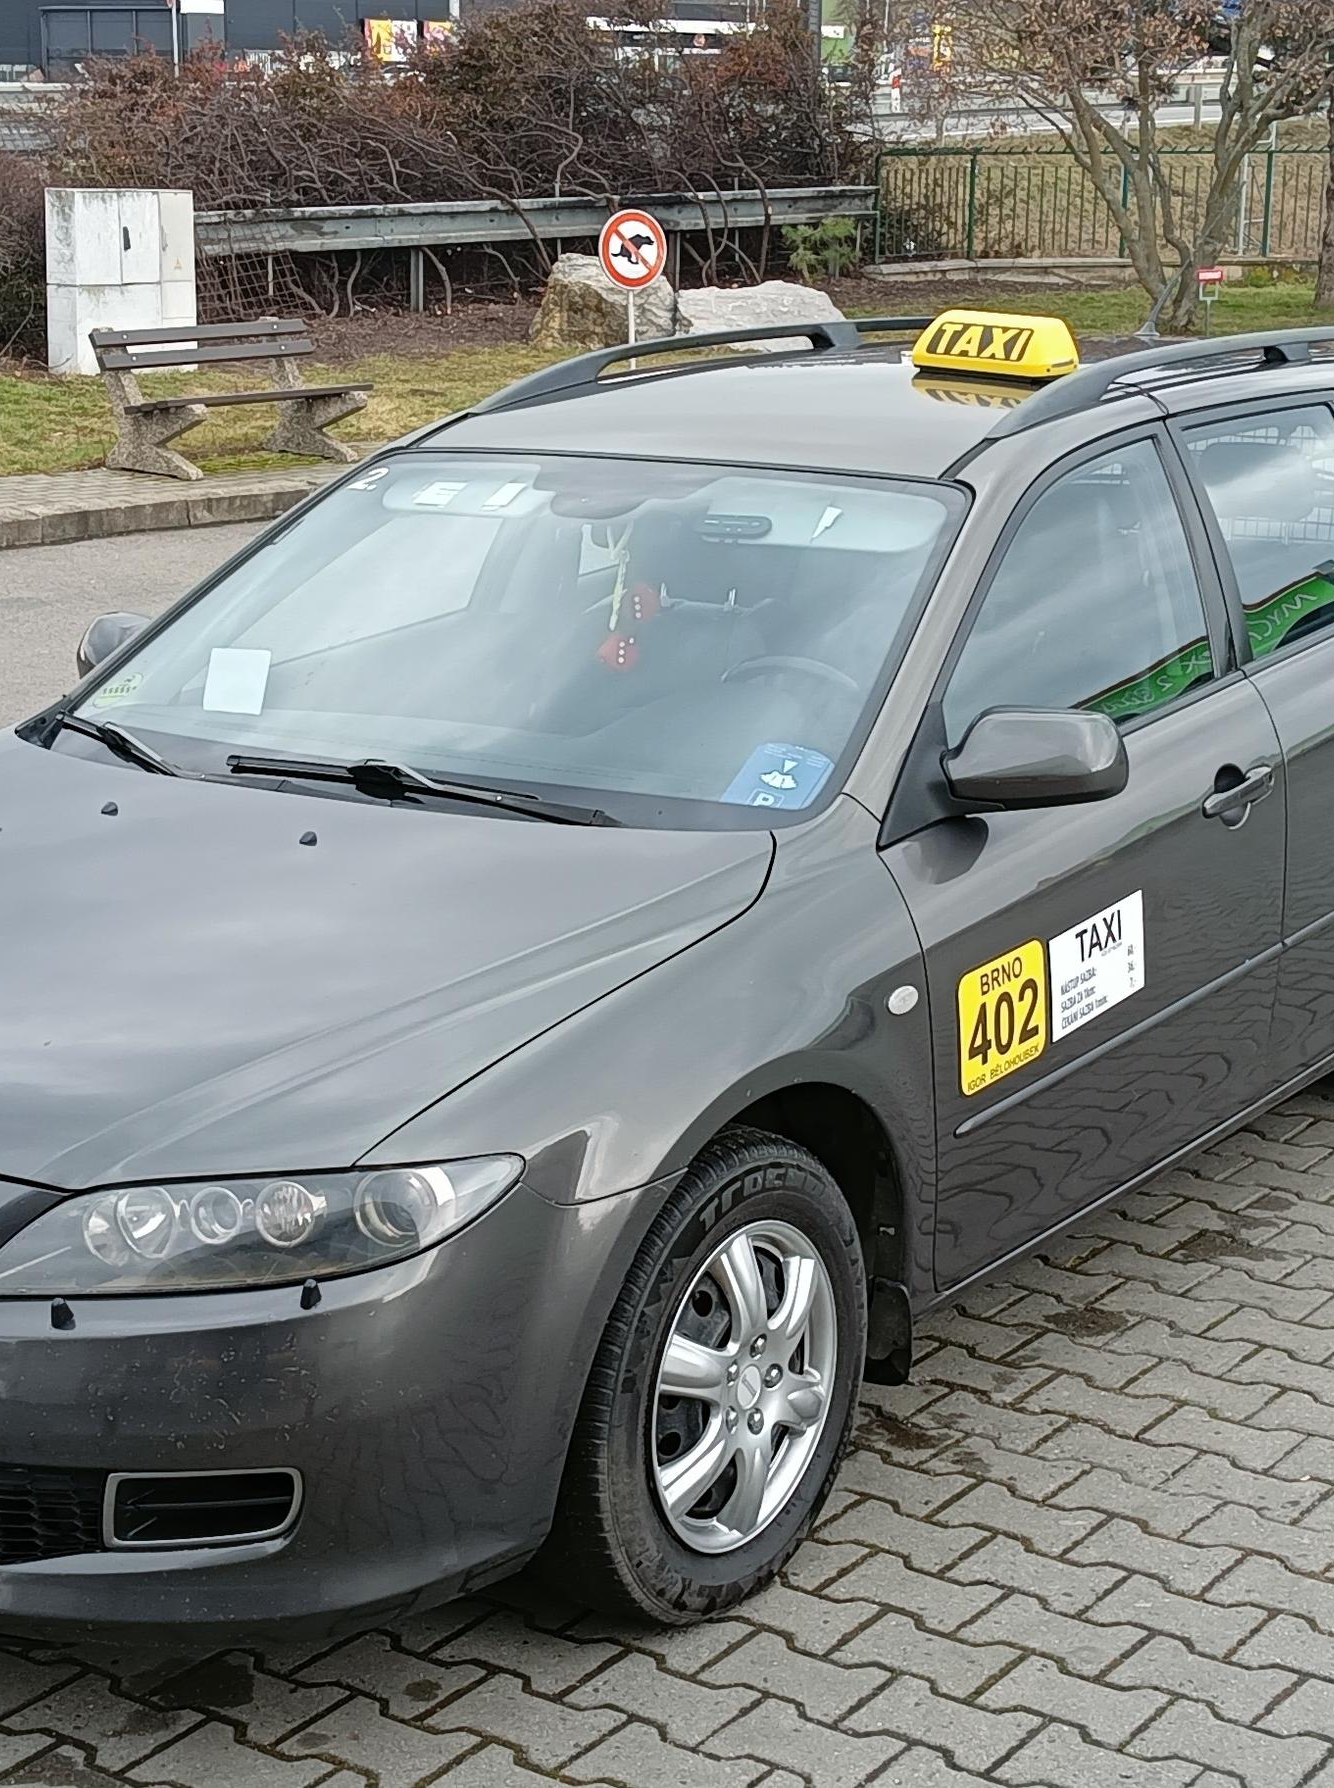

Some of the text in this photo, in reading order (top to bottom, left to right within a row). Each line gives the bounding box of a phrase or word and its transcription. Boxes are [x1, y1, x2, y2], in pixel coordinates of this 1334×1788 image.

[935, 323, 1032, 361] TAXI
[1075, 909, 1123, 962] TAXI
[980, 956, 1023, 996] BRNO
[968, 978, 1039, 1066] 402
[967, 1073, 987, 1092] IGOR
